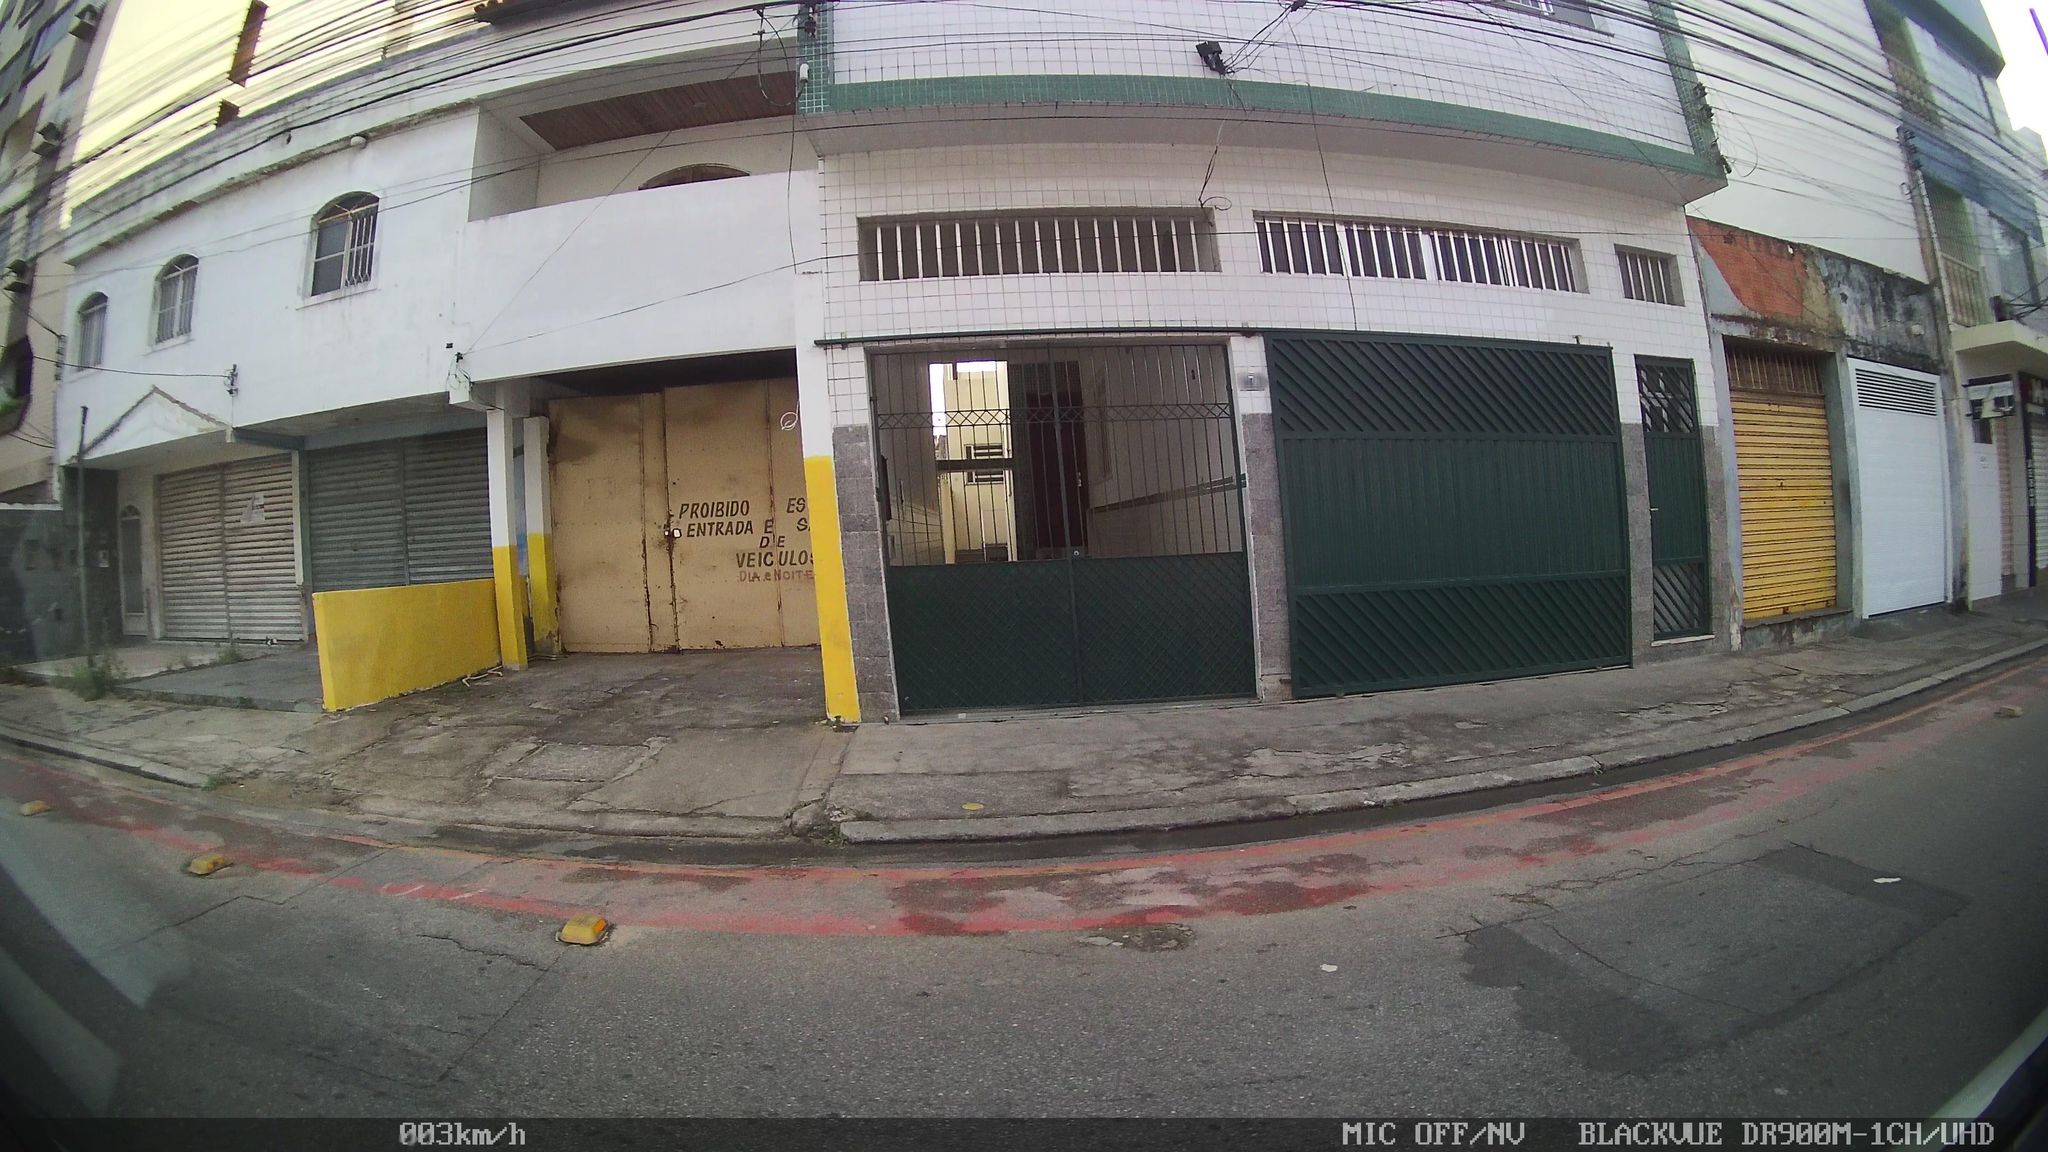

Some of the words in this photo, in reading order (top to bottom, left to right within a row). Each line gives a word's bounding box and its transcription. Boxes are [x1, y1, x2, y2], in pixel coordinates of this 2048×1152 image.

[679, 500, 749, 519] PROIBIDO
[687, 520, 753, 537] ENTRADA
[764, 519, 774, 533] E
[796, 517, 811, 531] S
